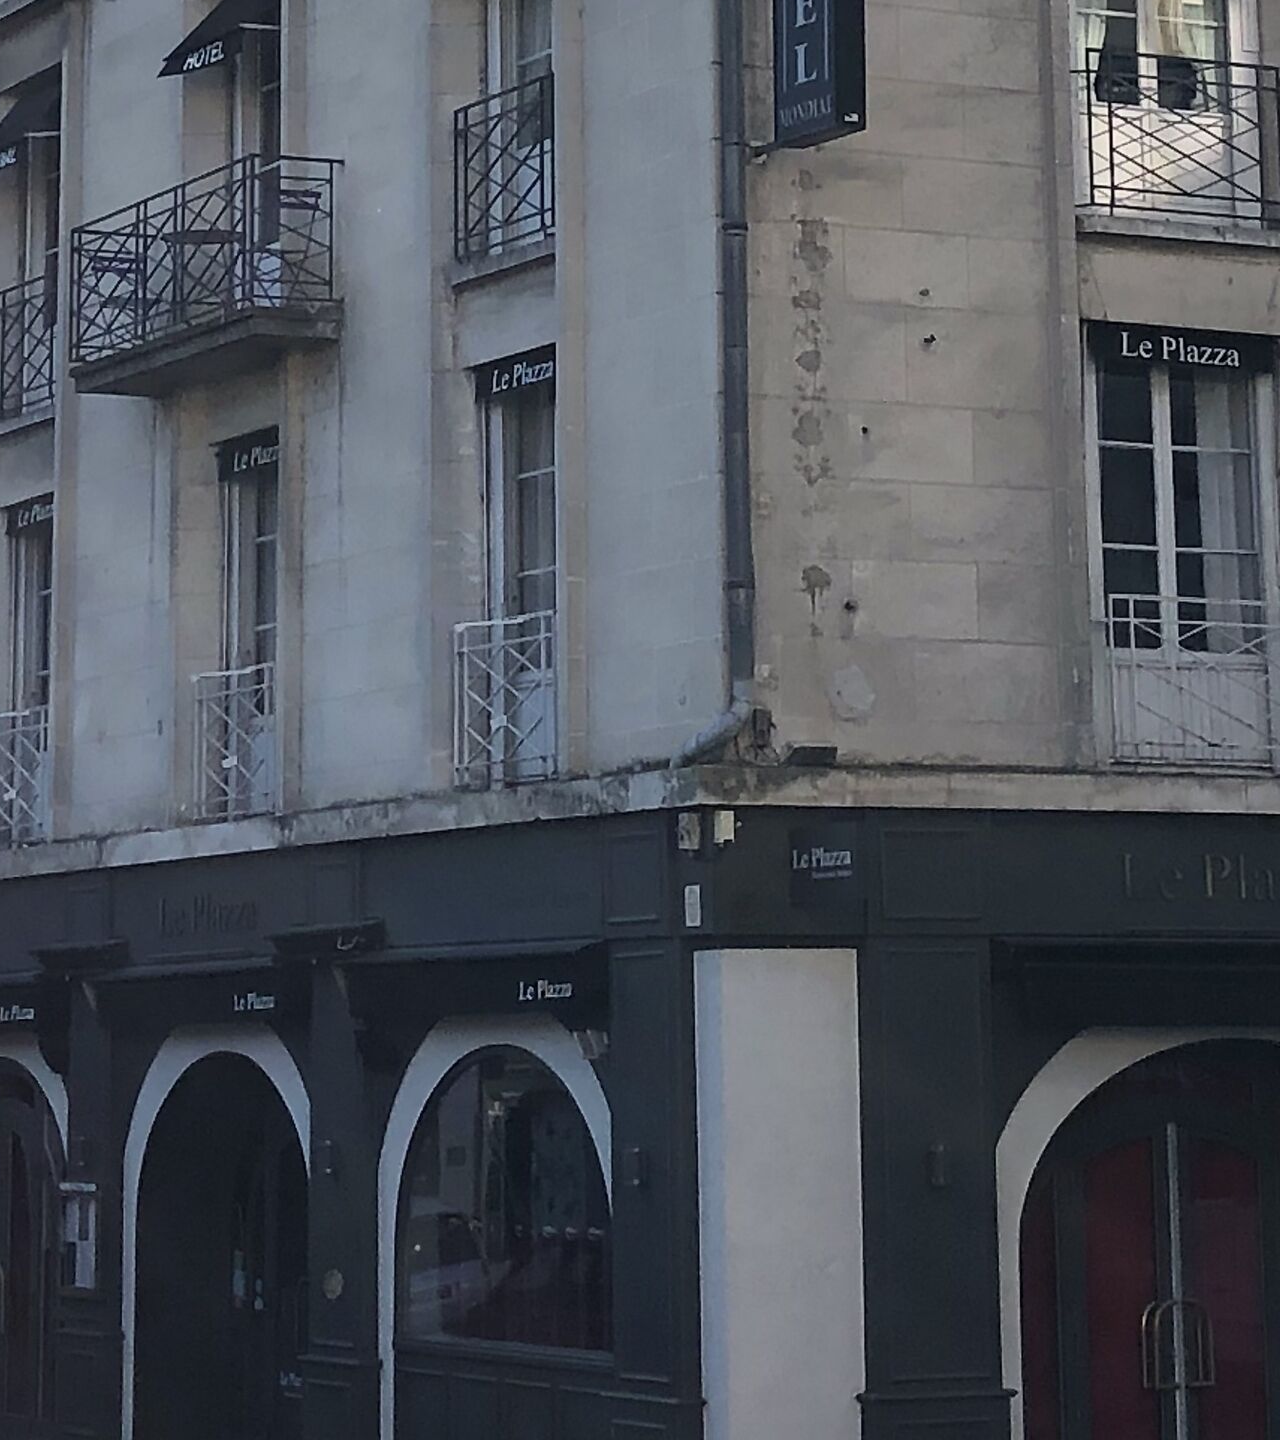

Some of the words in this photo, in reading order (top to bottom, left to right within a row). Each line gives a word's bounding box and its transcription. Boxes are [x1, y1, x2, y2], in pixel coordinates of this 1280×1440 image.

[182, 40, 225, 71] HOTEL
[1120, 331, 1153, 359] Le
[1160, 335, 1240, 368] Plazza
[491, 369, 510, 394] Le
[233, 451, 249, 472] Le
[792, 848, 809, 869] Le
[1121, 852, 1186, 900] Le
[518, 980, 535, 1001] Le
